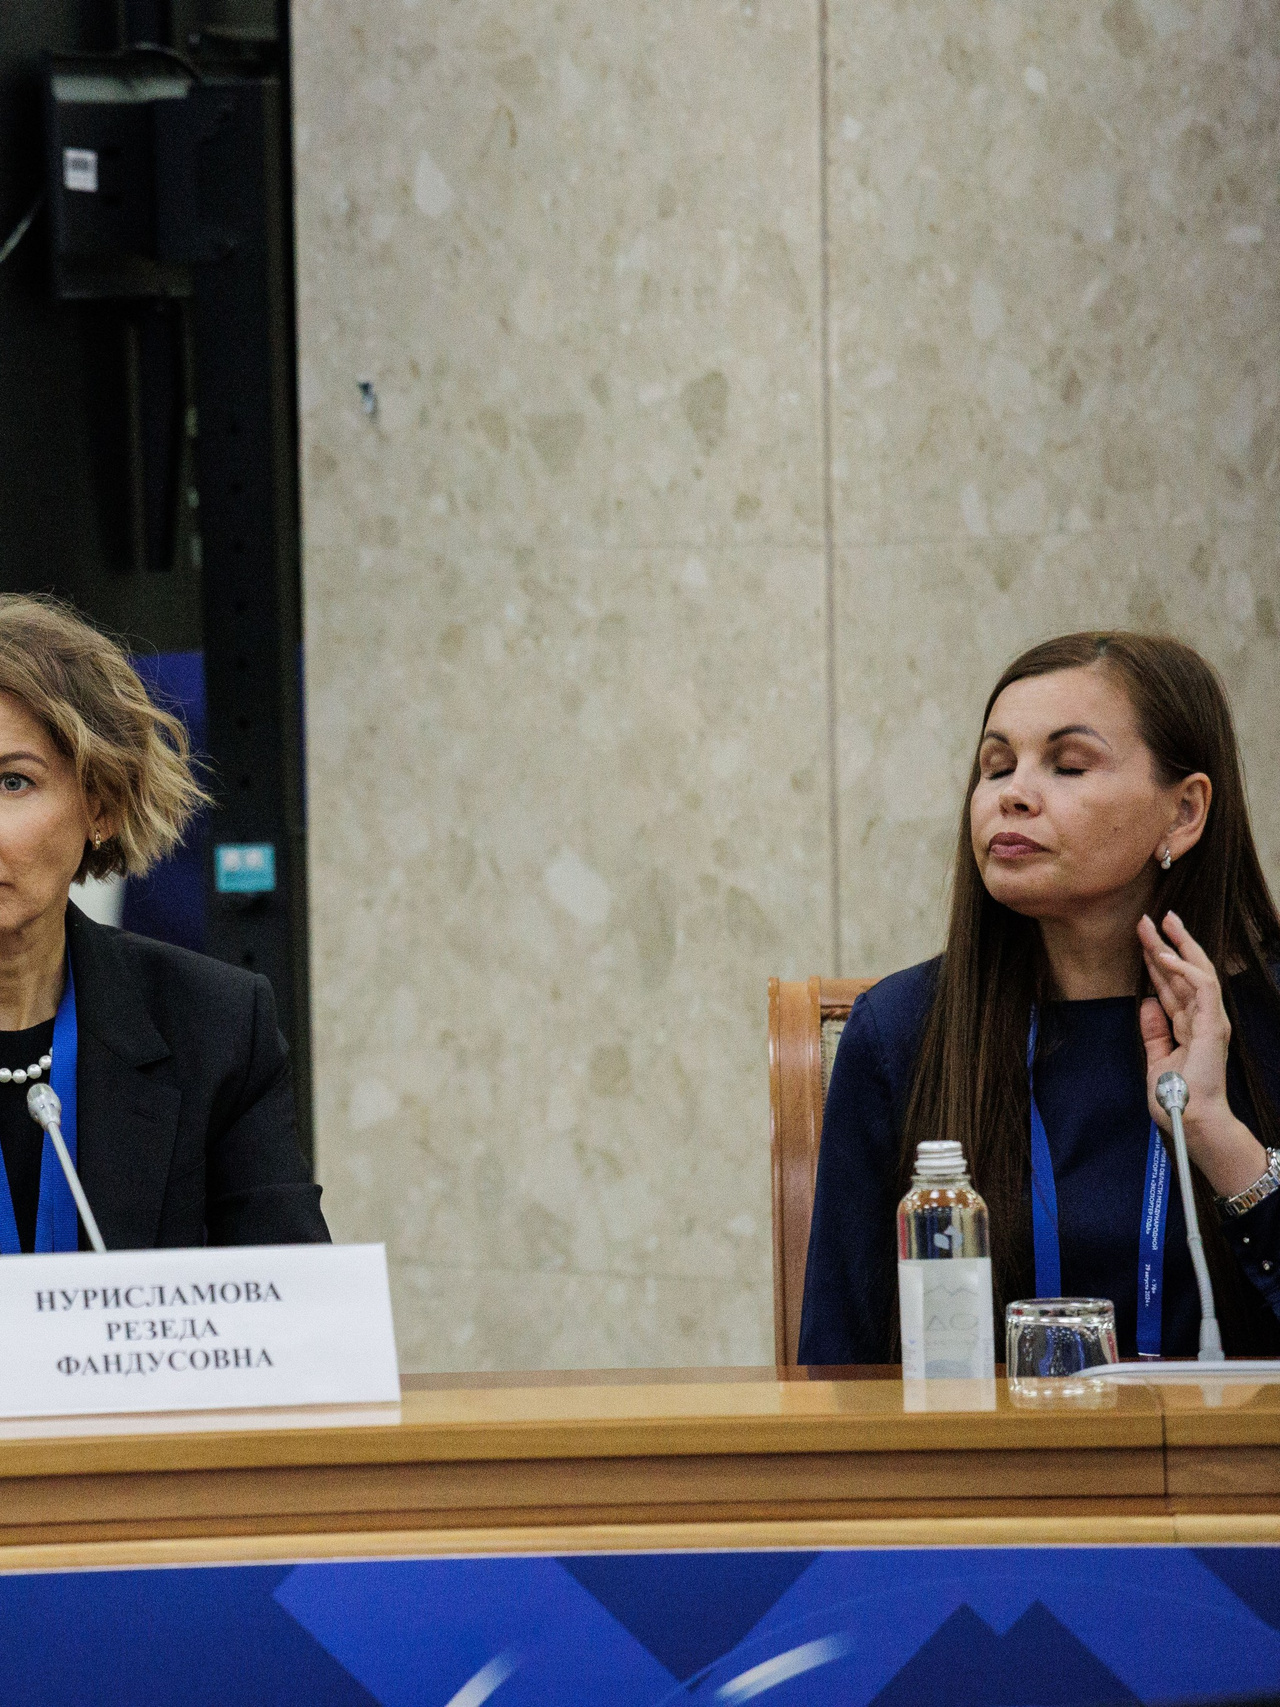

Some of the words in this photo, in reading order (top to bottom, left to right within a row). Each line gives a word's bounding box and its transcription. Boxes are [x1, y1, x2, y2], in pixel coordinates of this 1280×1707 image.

[1151, 1149, 1160, 1179] ЭКСПОРТА
[1157, 1168, 1165, 1195] ОБЛАСТИ
[1152, 1195, 1162, 1250] МЕЖДУНАРОДНОЙ
[34, 1281, 283, 1313] НУРИСЛАМОВА
[105, 1318, 219, 1342] РЕЗЕДА
[55, 1347, 275, 1377] ФАНДУСОВНА
